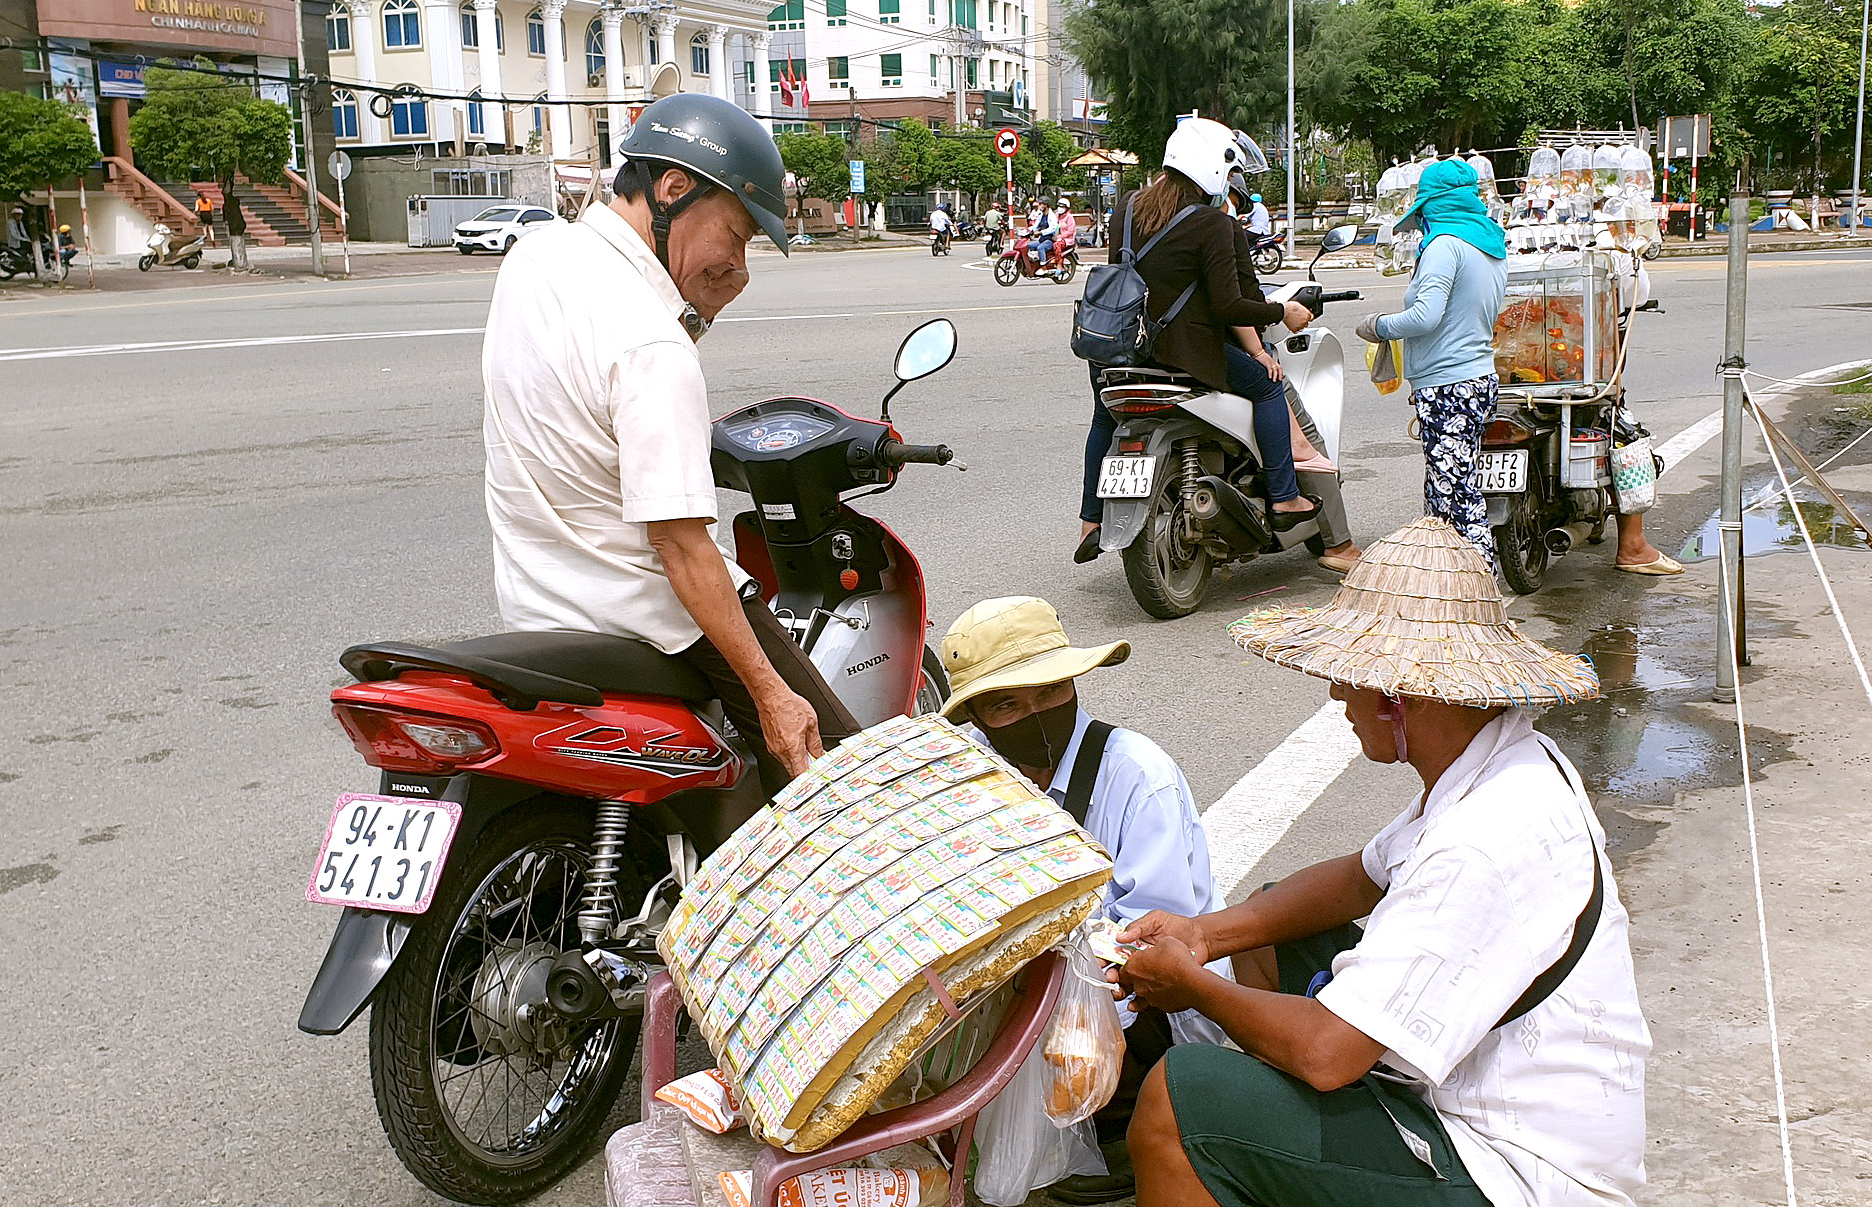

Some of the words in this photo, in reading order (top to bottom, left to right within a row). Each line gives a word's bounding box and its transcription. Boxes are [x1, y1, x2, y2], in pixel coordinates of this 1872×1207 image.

[700, 137, 728, 156] Group
[1109, 459, 1146, 476] 69-K1
[1477, 453, 1518, 470] 69-F2
[1101, 478, 1148, 495] 424.13
[846, 653, 891, 676] HONDA
[391, 783, 430, 794] HONDA
[345, 805, 435, 852] 94-K1
[319, 851, 432, 903] 541.31
[873, 1171, 882, 1204] Bakery
